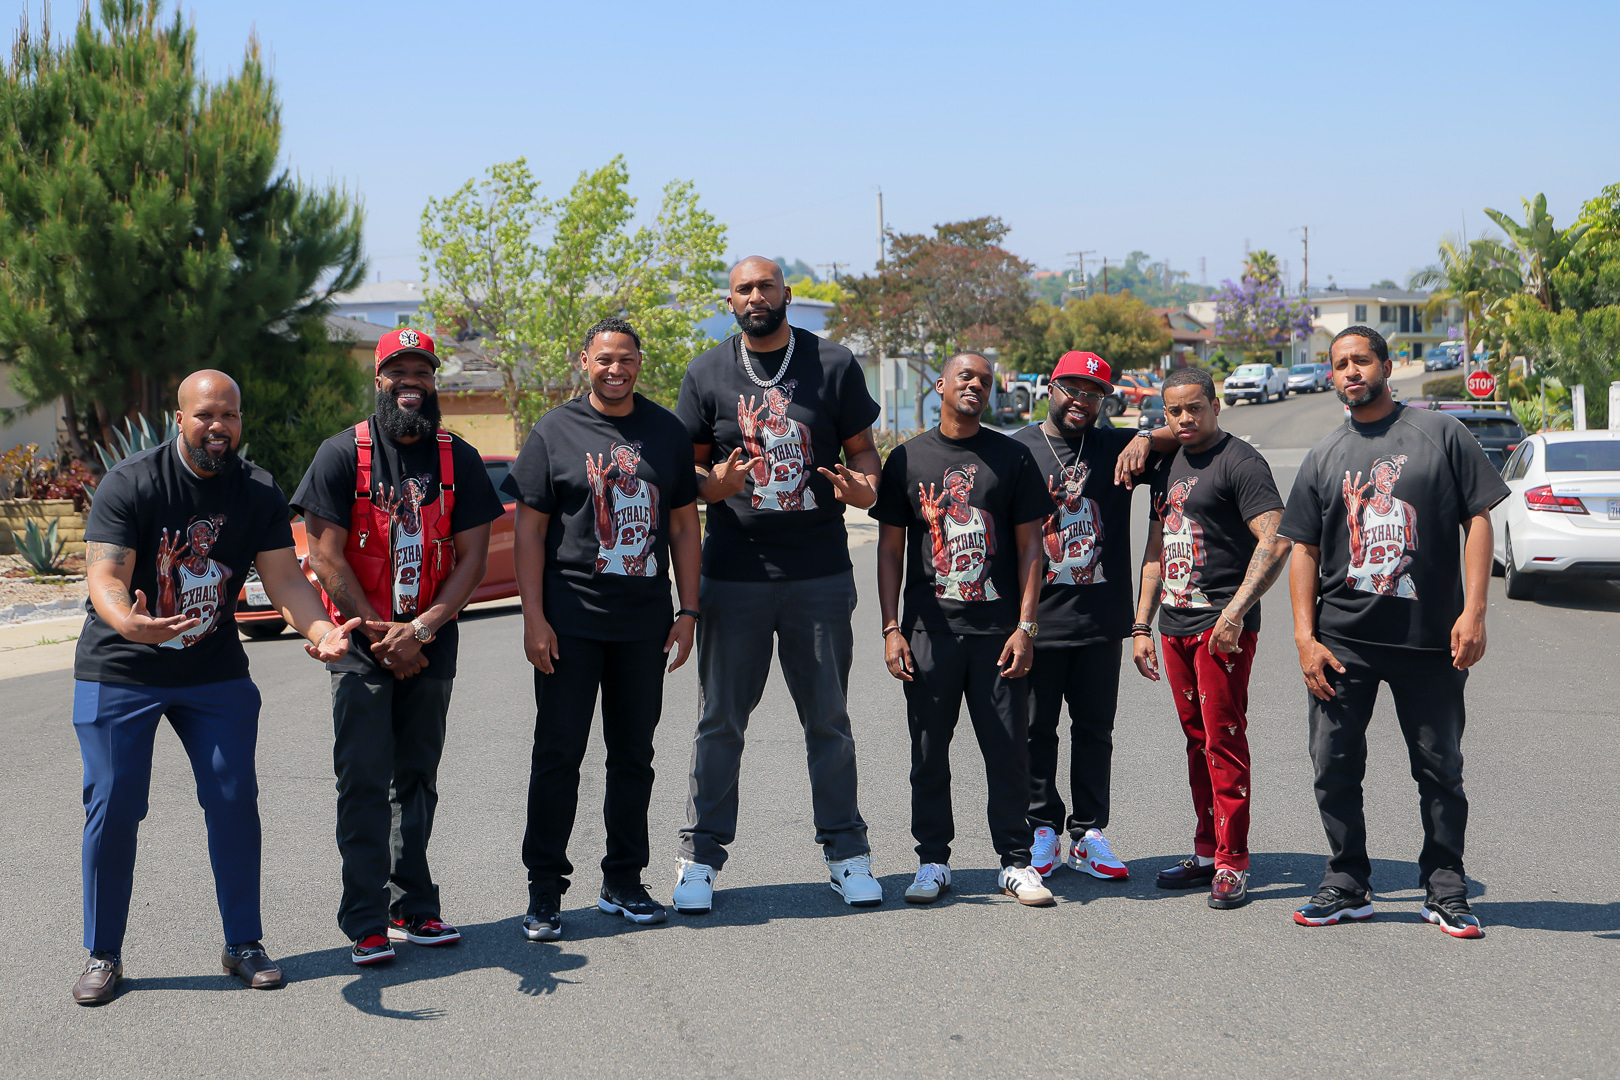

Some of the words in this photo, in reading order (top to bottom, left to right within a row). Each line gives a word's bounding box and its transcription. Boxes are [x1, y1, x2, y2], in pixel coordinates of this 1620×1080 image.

[1469, 378, 1493, 390] STOP
[766, 443, 801, 468] EXHALE
[615, 505, 650, 528] EXHALE
[1061, 520, 1092, 542] EXHALE
[1364, 524, 1403, 547] EXHALE
[396, 544, 423, 567] EXHA
[947, 532, 984, 556] EXHALE
[1163, 542, 1191, 563] EXHALE
[181, 585, 217, 609] EXHALE
